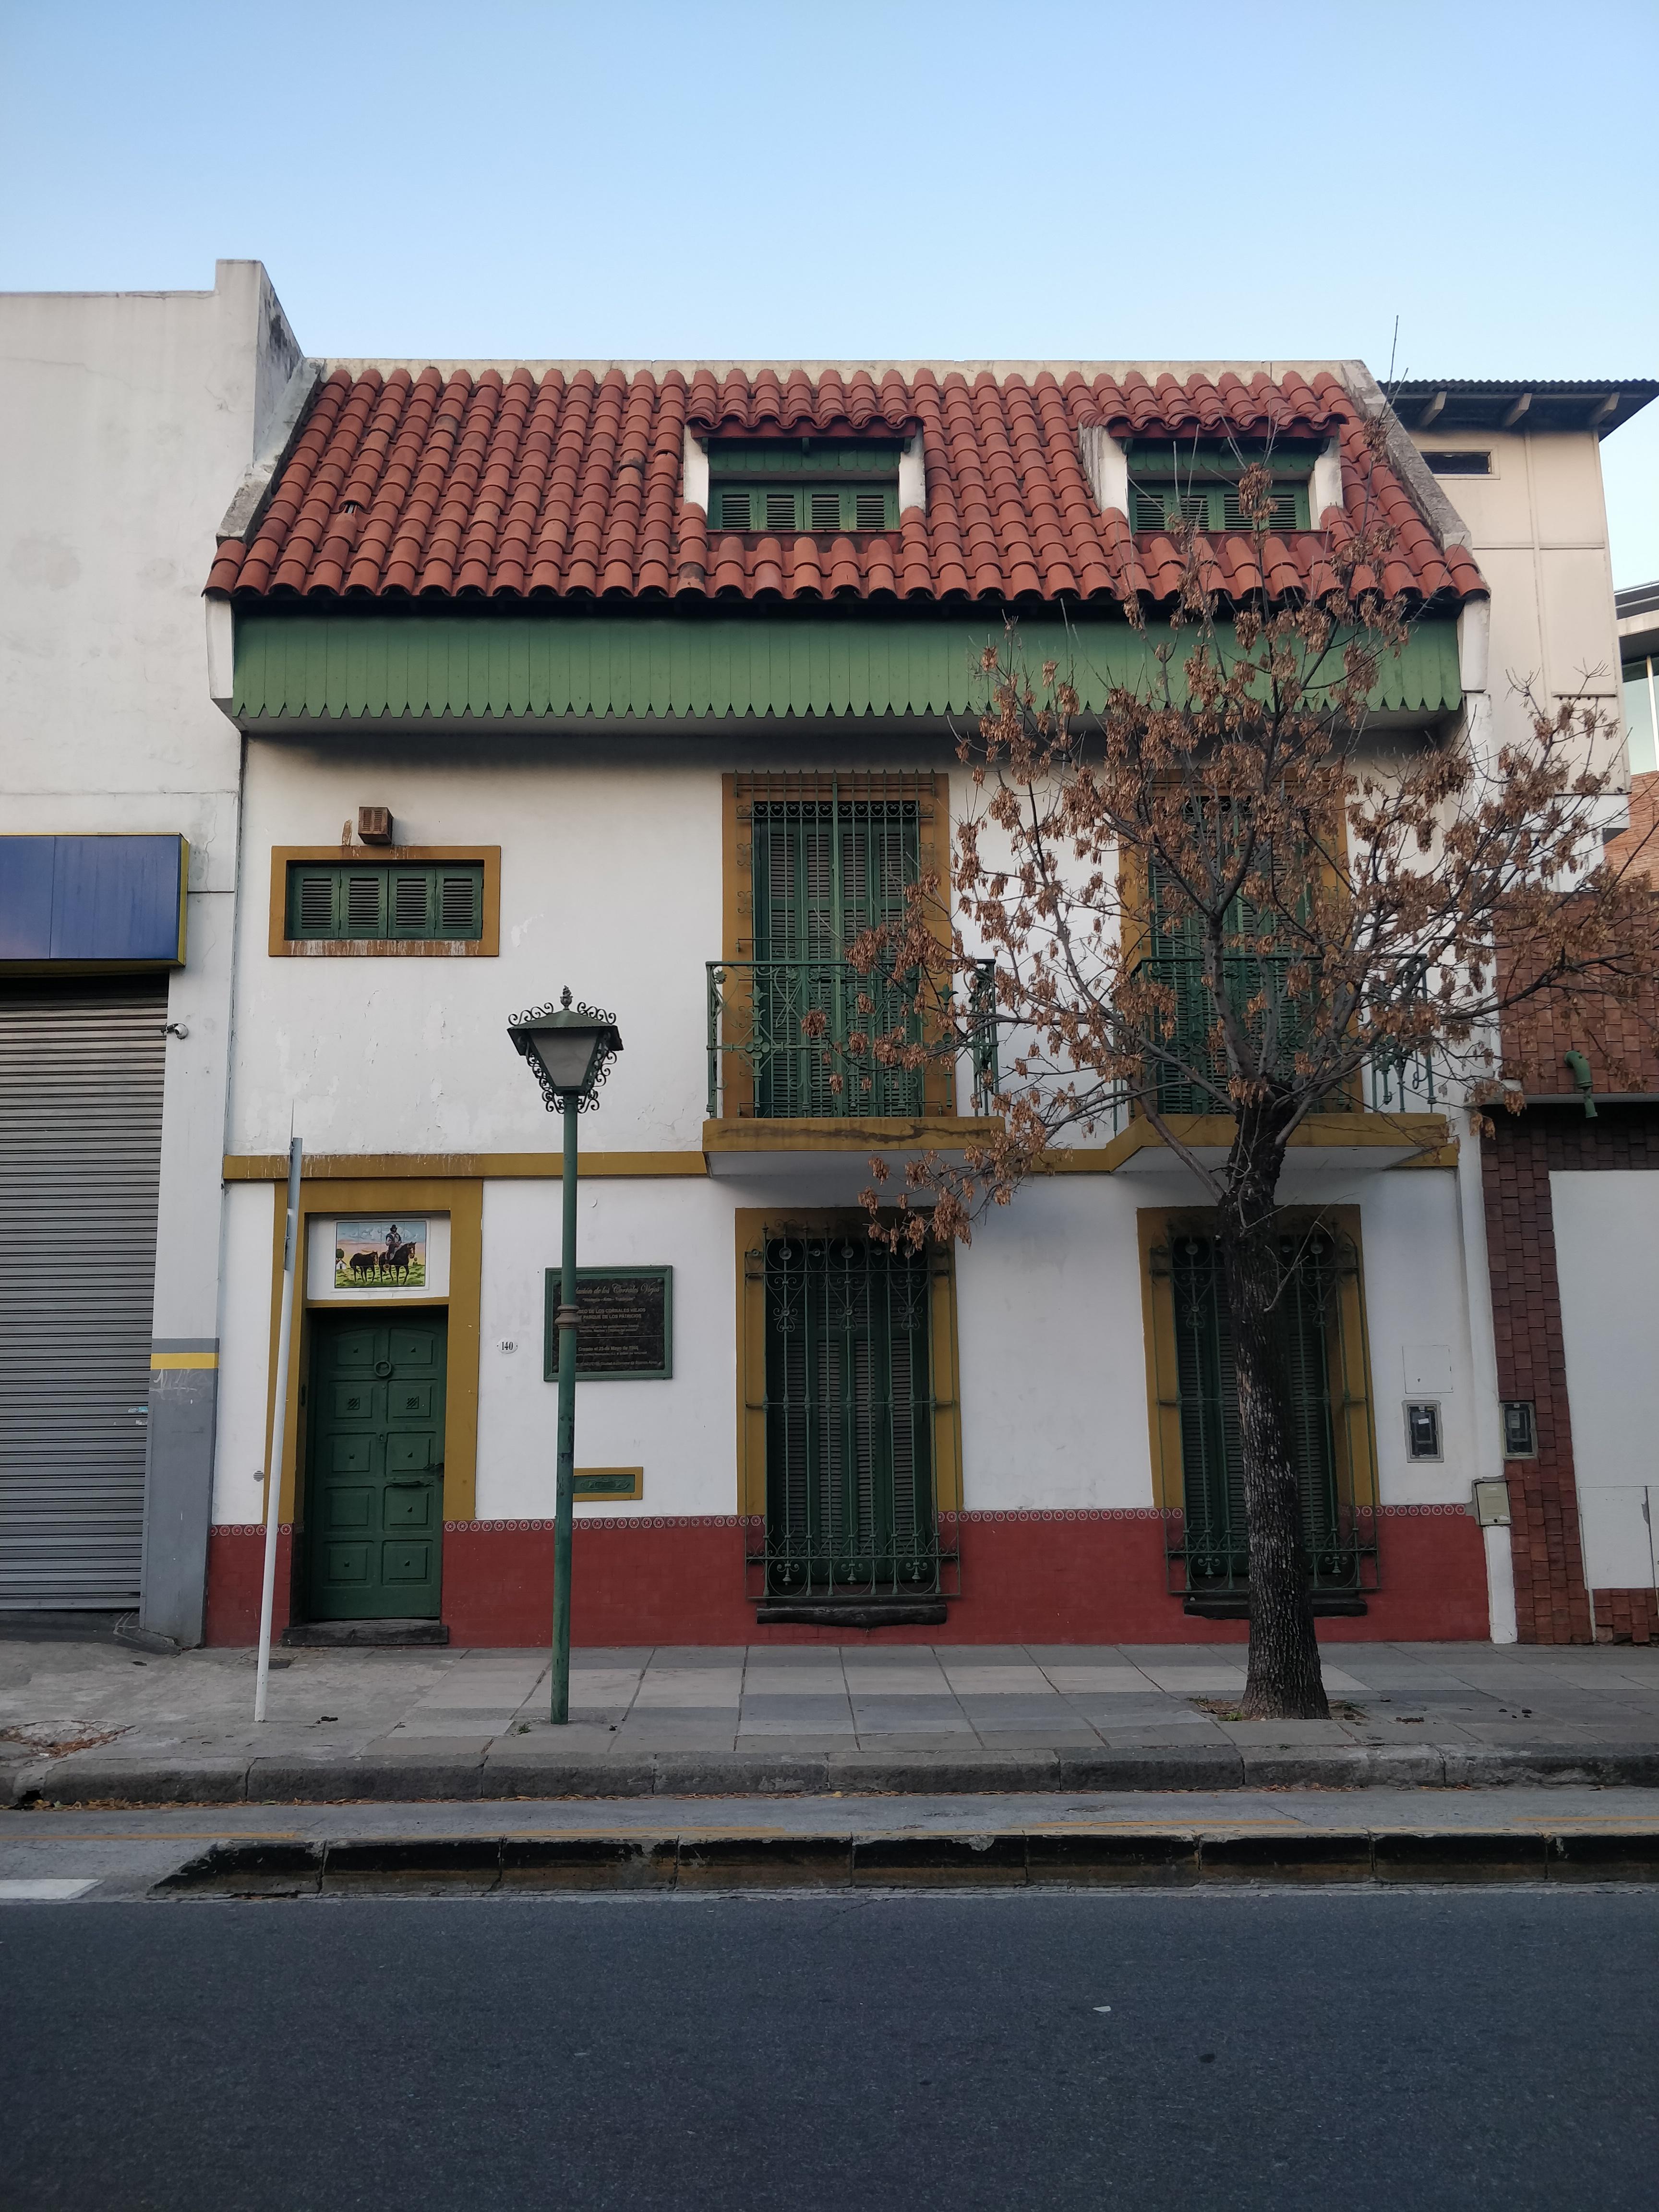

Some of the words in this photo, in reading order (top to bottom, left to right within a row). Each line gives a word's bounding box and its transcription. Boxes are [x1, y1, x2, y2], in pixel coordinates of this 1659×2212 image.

[612, 1283, 639, 1293] Corrales
[640, 1282, 660, 1297] Viejos
[501, 1341, 513, 1350] 140
